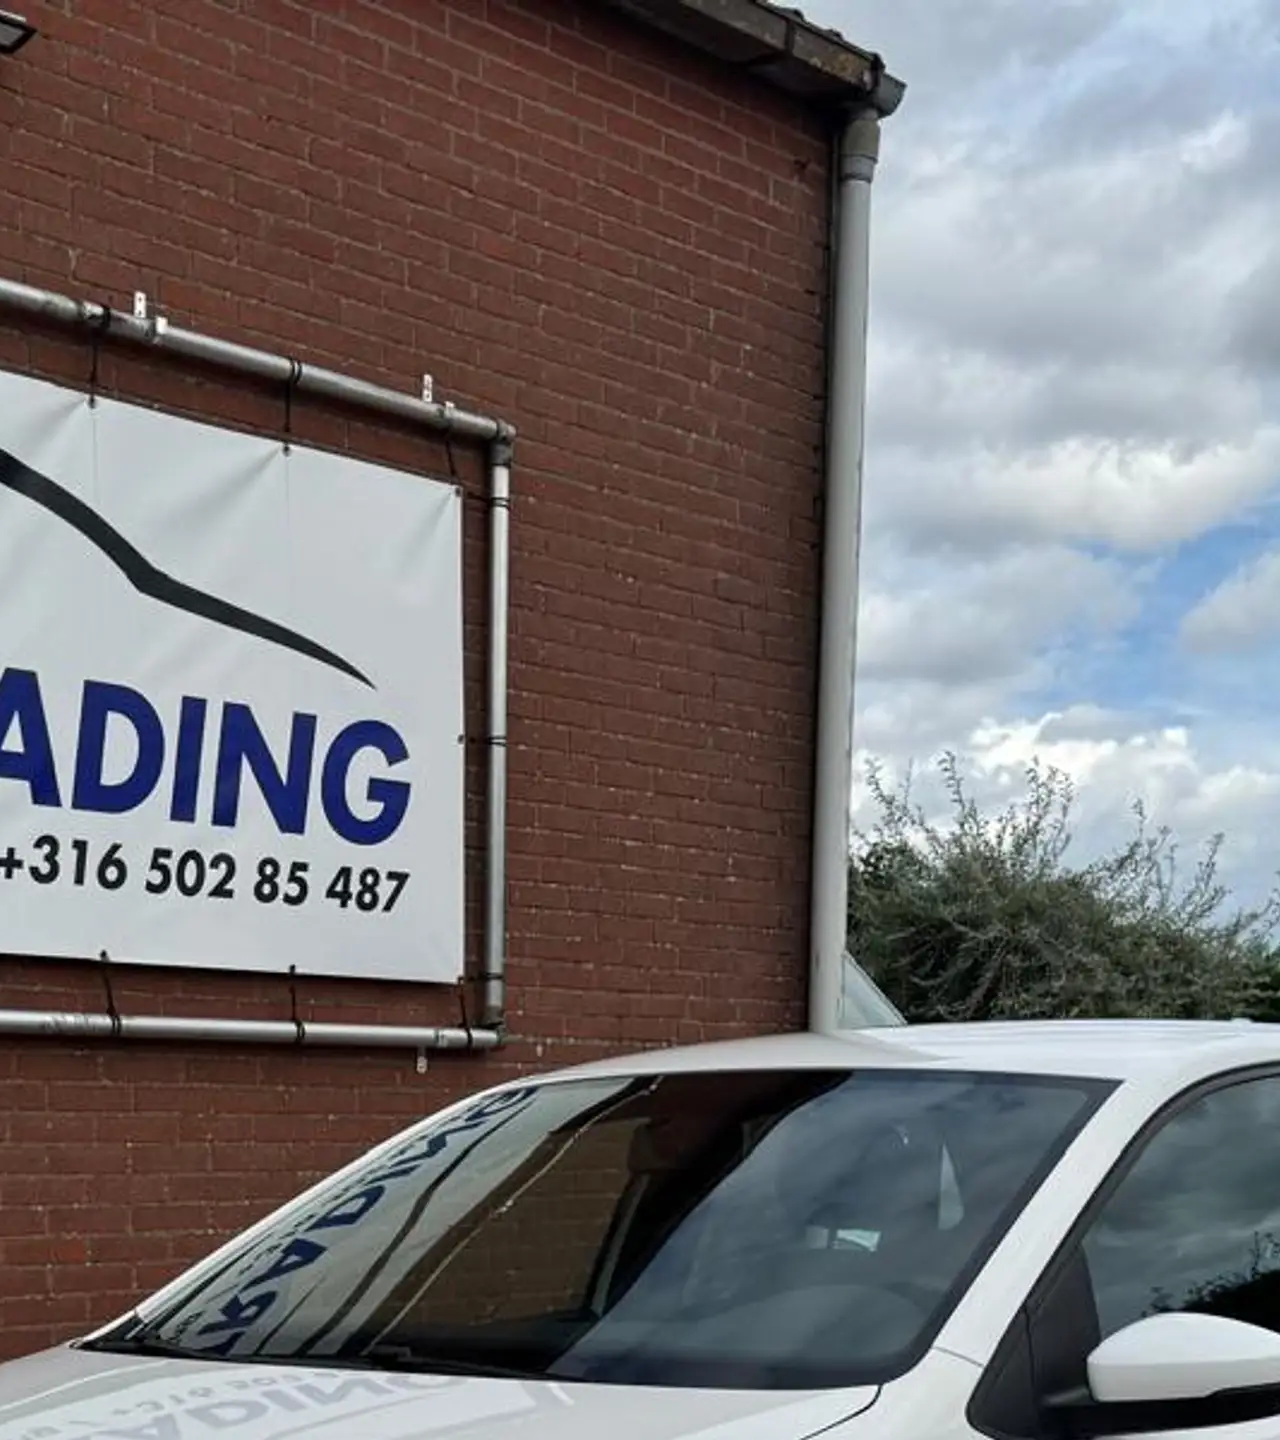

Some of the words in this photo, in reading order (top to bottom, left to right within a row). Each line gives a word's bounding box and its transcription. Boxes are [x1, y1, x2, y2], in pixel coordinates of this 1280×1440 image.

[146, 847, 236, 901] 502
[253, 857, 310, 908] 85
[325, 866, 411, 913] 487
